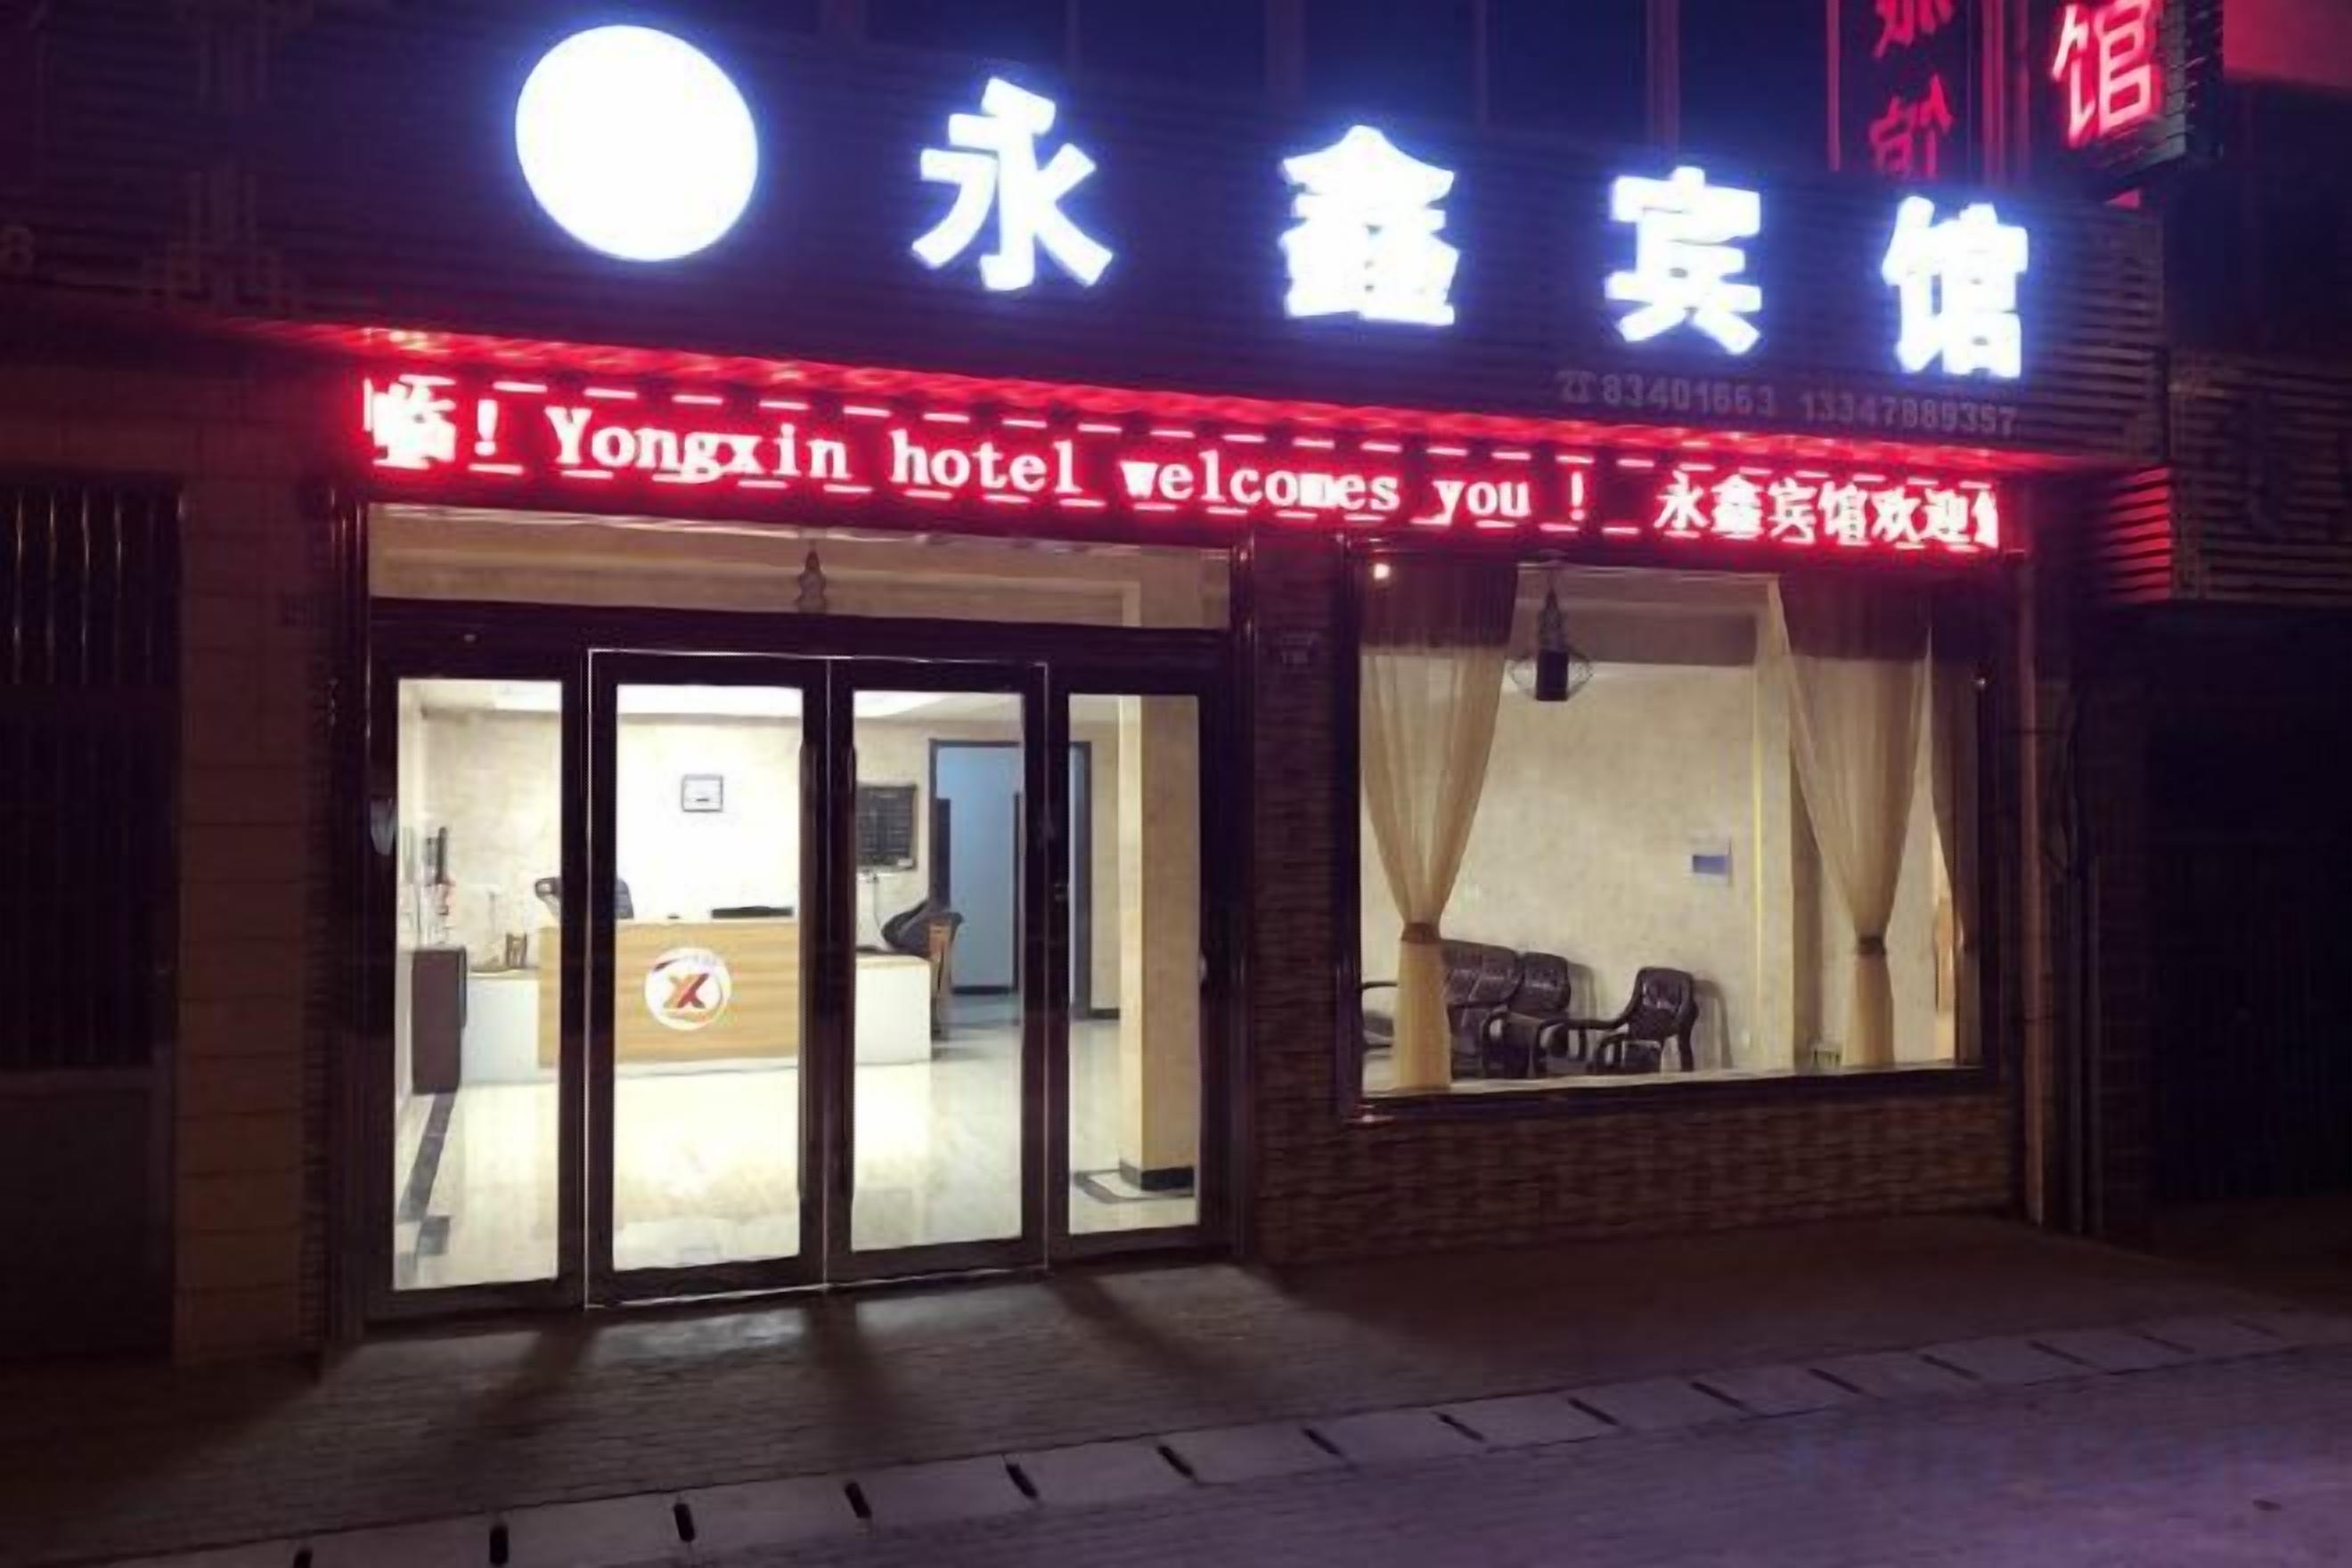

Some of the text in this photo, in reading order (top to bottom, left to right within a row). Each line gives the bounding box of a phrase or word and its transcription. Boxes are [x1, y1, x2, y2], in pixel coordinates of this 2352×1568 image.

[2052, 0, 2152, 148] 馆
[913, 79, 2027, 376] 永鑫宾馆
[545, 406, 853, 482] Yongxin
[890, 429, 1084, 495] hotel
[1120, 448, 1401, 511] welcomes
[1431, 480, 1531, 526] you
